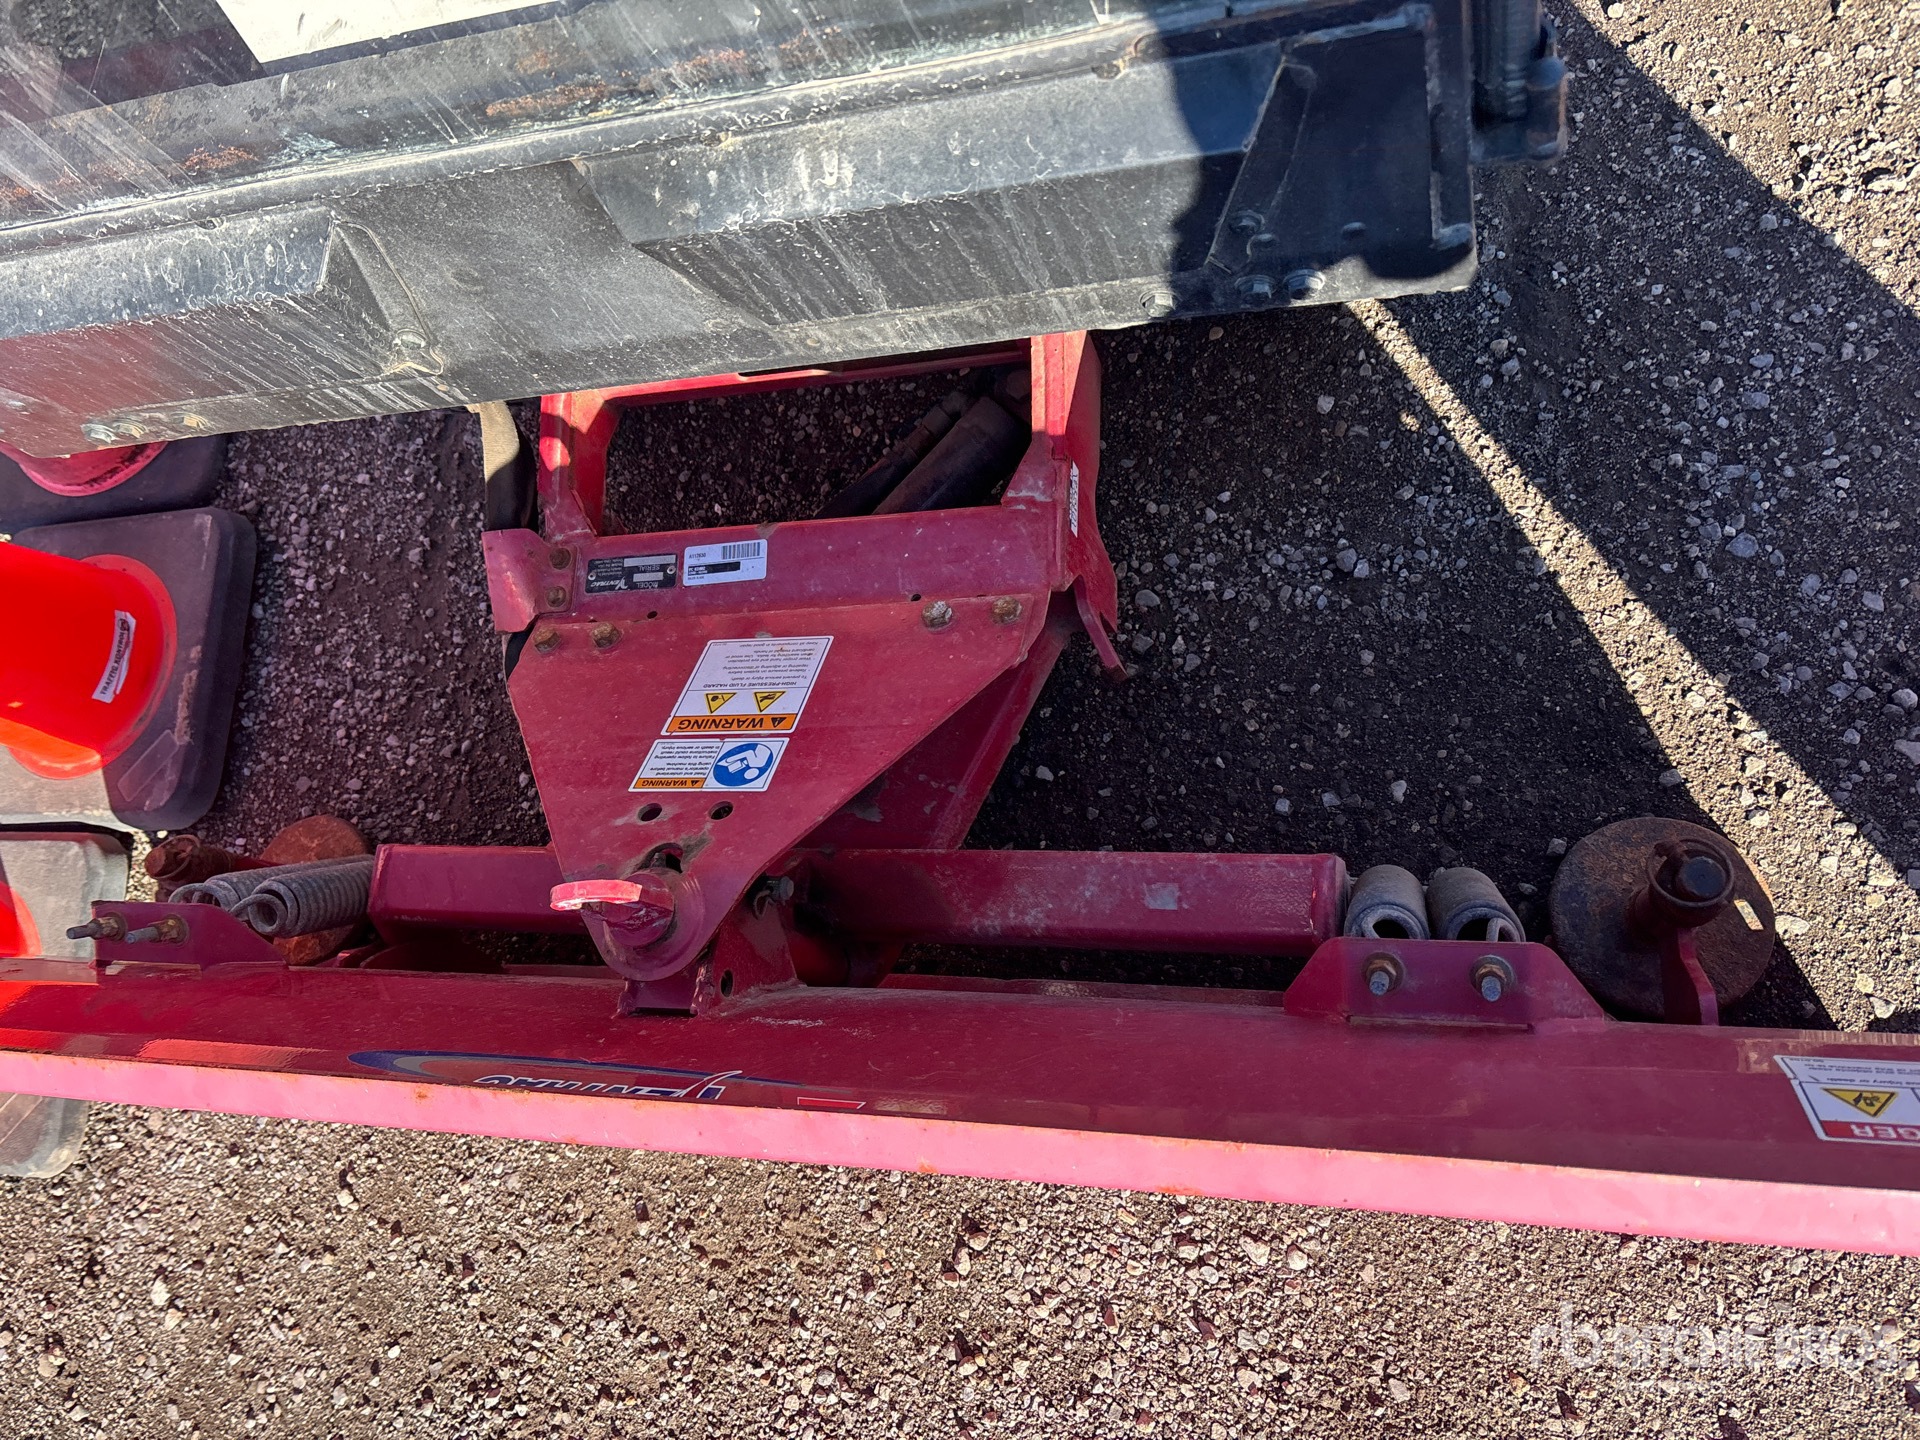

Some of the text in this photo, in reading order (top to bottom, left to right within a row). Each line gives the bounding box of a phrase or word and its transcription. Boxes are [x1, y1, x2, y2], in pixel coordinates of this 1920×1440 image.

[591, 576, 628, 590] VENTRAC
[636, 581, 658, 589] MODEL
[100, 665, 118, 695] TRAFFIC
[677, 717, 764, 730] WARNING
